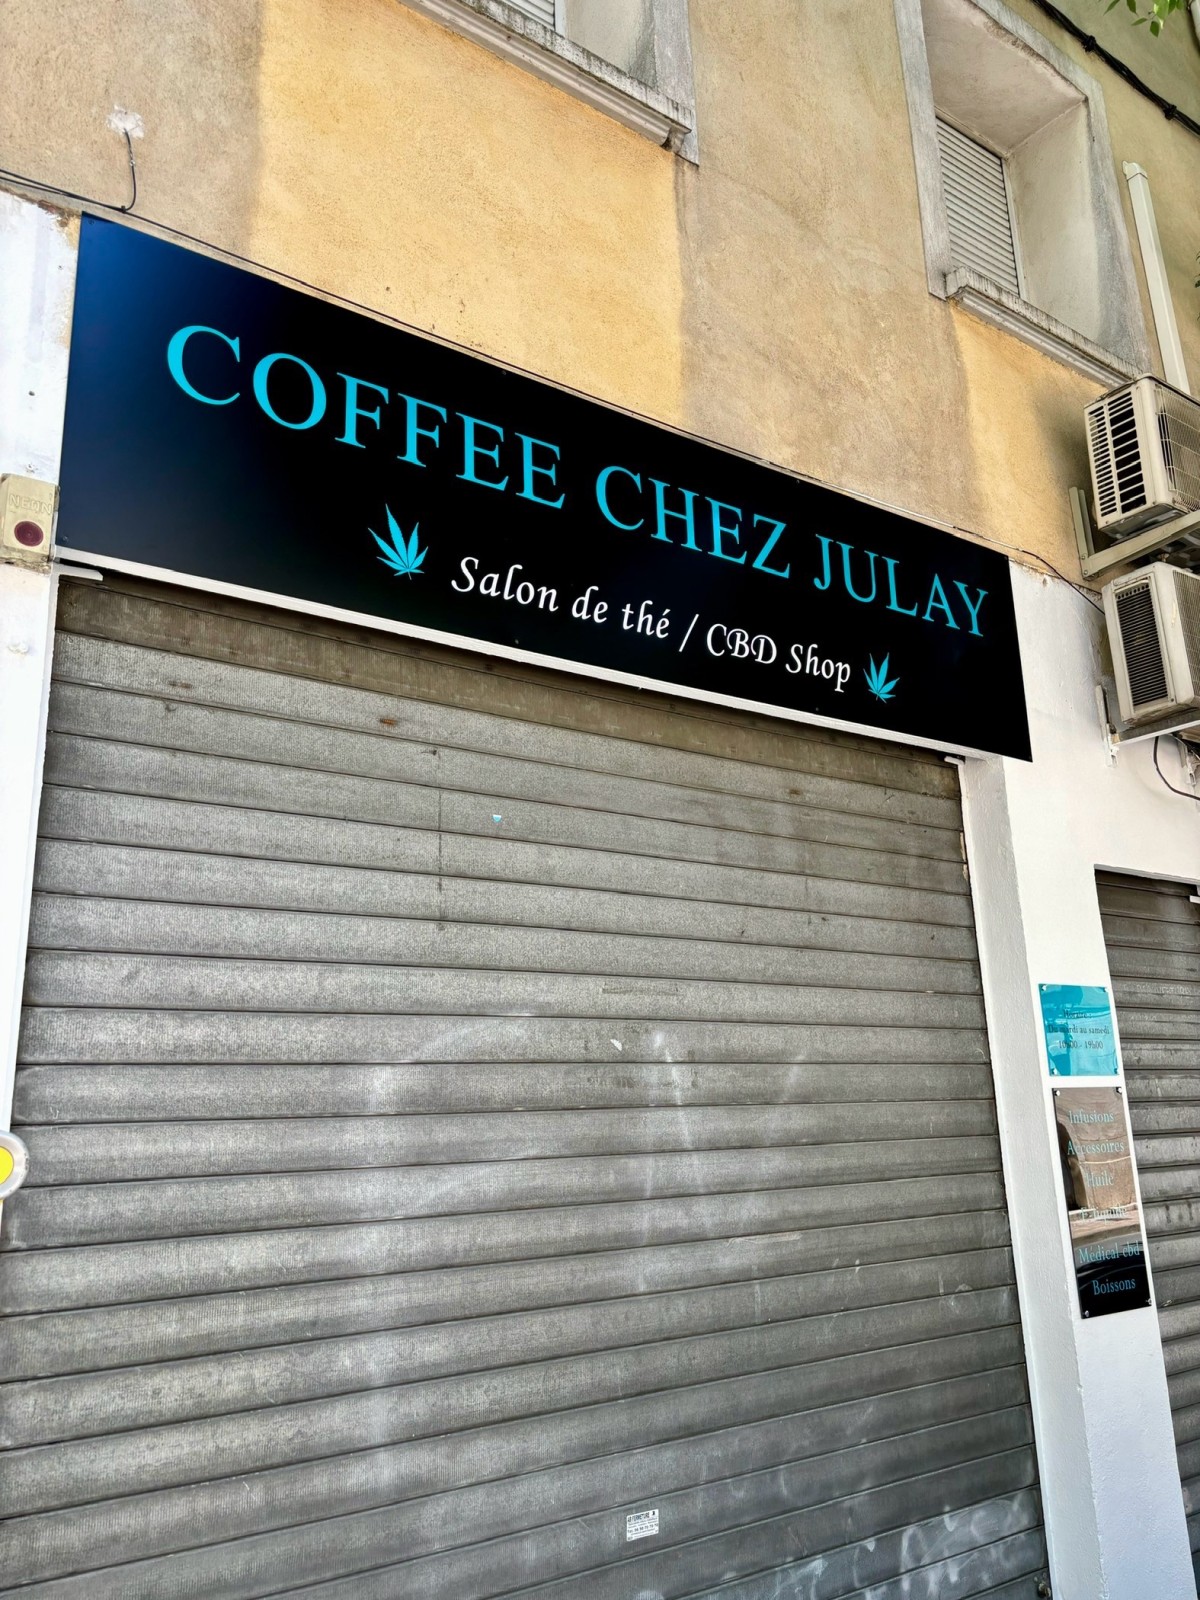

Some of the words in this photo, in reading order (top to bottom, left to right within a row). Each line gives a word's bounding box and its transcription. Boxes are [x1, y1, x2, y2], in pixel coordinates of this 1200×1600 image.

[167, 326, 564, 508] COFFEE
[596, 466, 789, 578] CHEZ
[814, 536, 987, 635] JULAY
[452, 557, 558, 611] Salon
[572, 586, 608, 623] de
[622, 600, 670, 638] thé
[679, 614, 699, 652] /
[707, 624, 776, 663] CBD
[786, 644, 850, 692] Shop
[1089, 1025, 1110, 1034] samedi
[1084, 1040, 1104, 1050] 19h00
[1068, 1109, 1115, 1124] Infusions
[1067, 1139, 1125, 1156] Accessoires
[1085, 1170, 1114, 1187] Huile
[1079, 1242, 1120, 1263] Médical
[1092, 1279, 1136, 1295] Boissons
